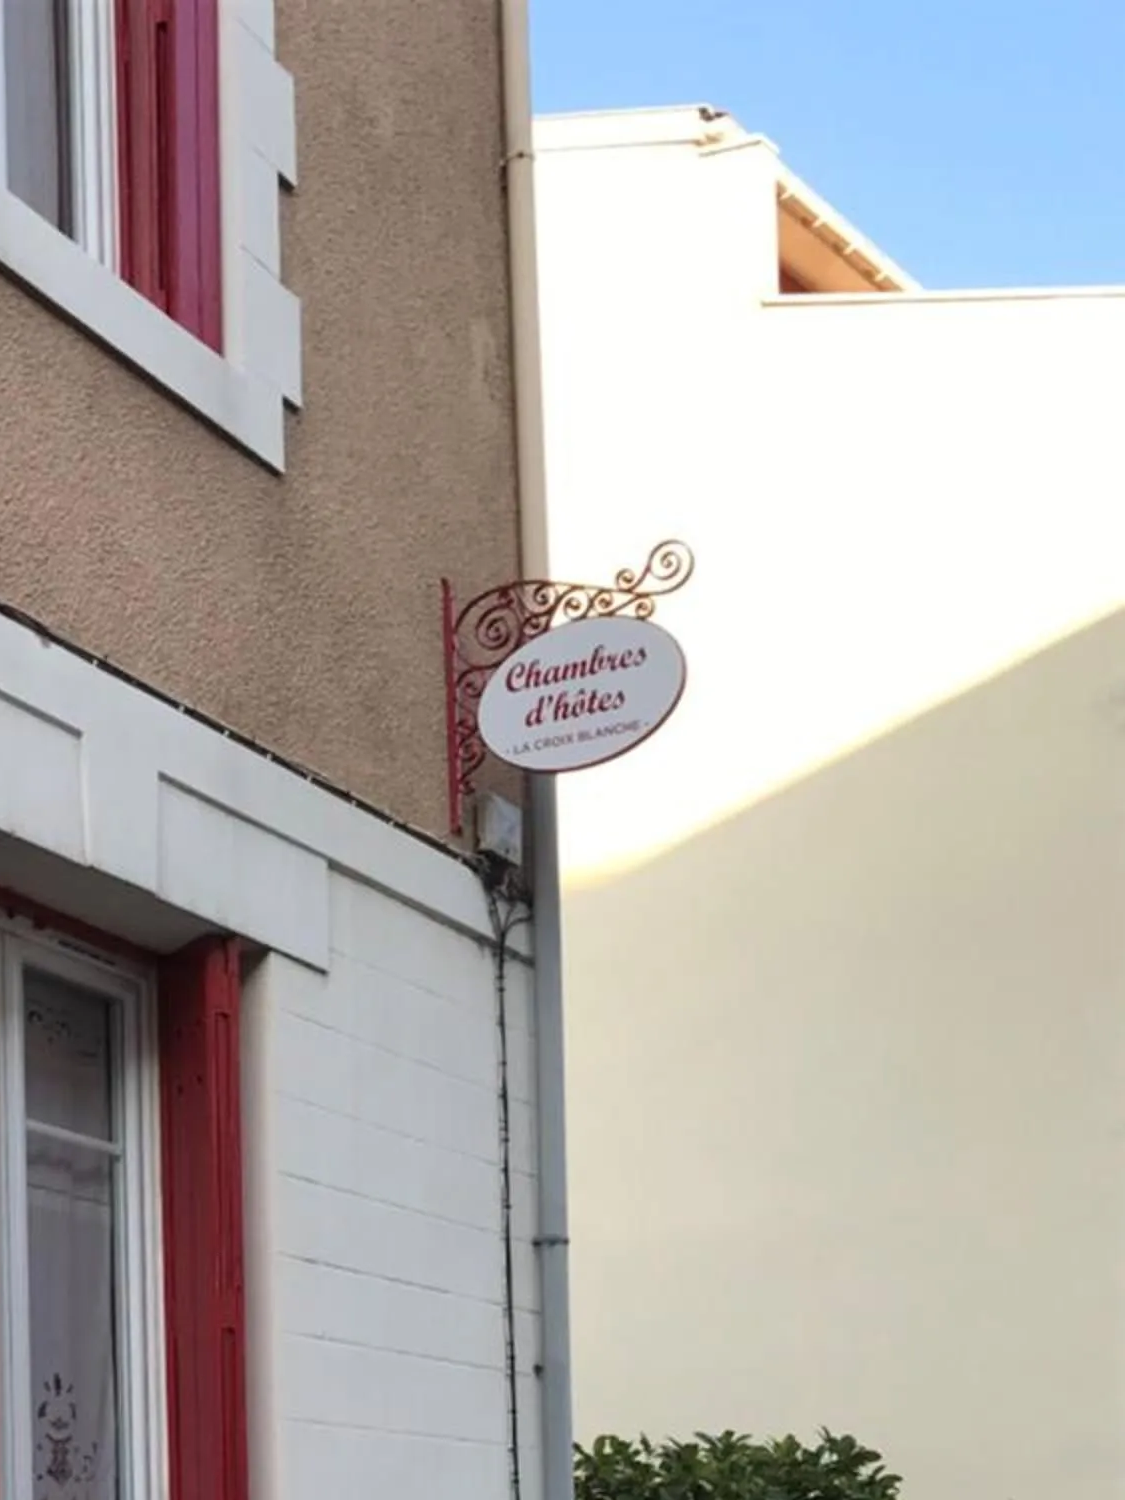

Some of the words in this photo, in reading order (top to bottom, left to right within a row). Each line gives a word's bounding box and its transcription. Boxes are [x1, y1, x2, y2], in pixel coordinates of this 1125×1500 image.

[505, 645, 647, 693] Chambres
[525, 688, 626, 727] d'hôtes
[512, 742, 531, 755] LA
[534, 733, 574, 751] CROIX
[577, 719, 641, 741] BLANCHE
